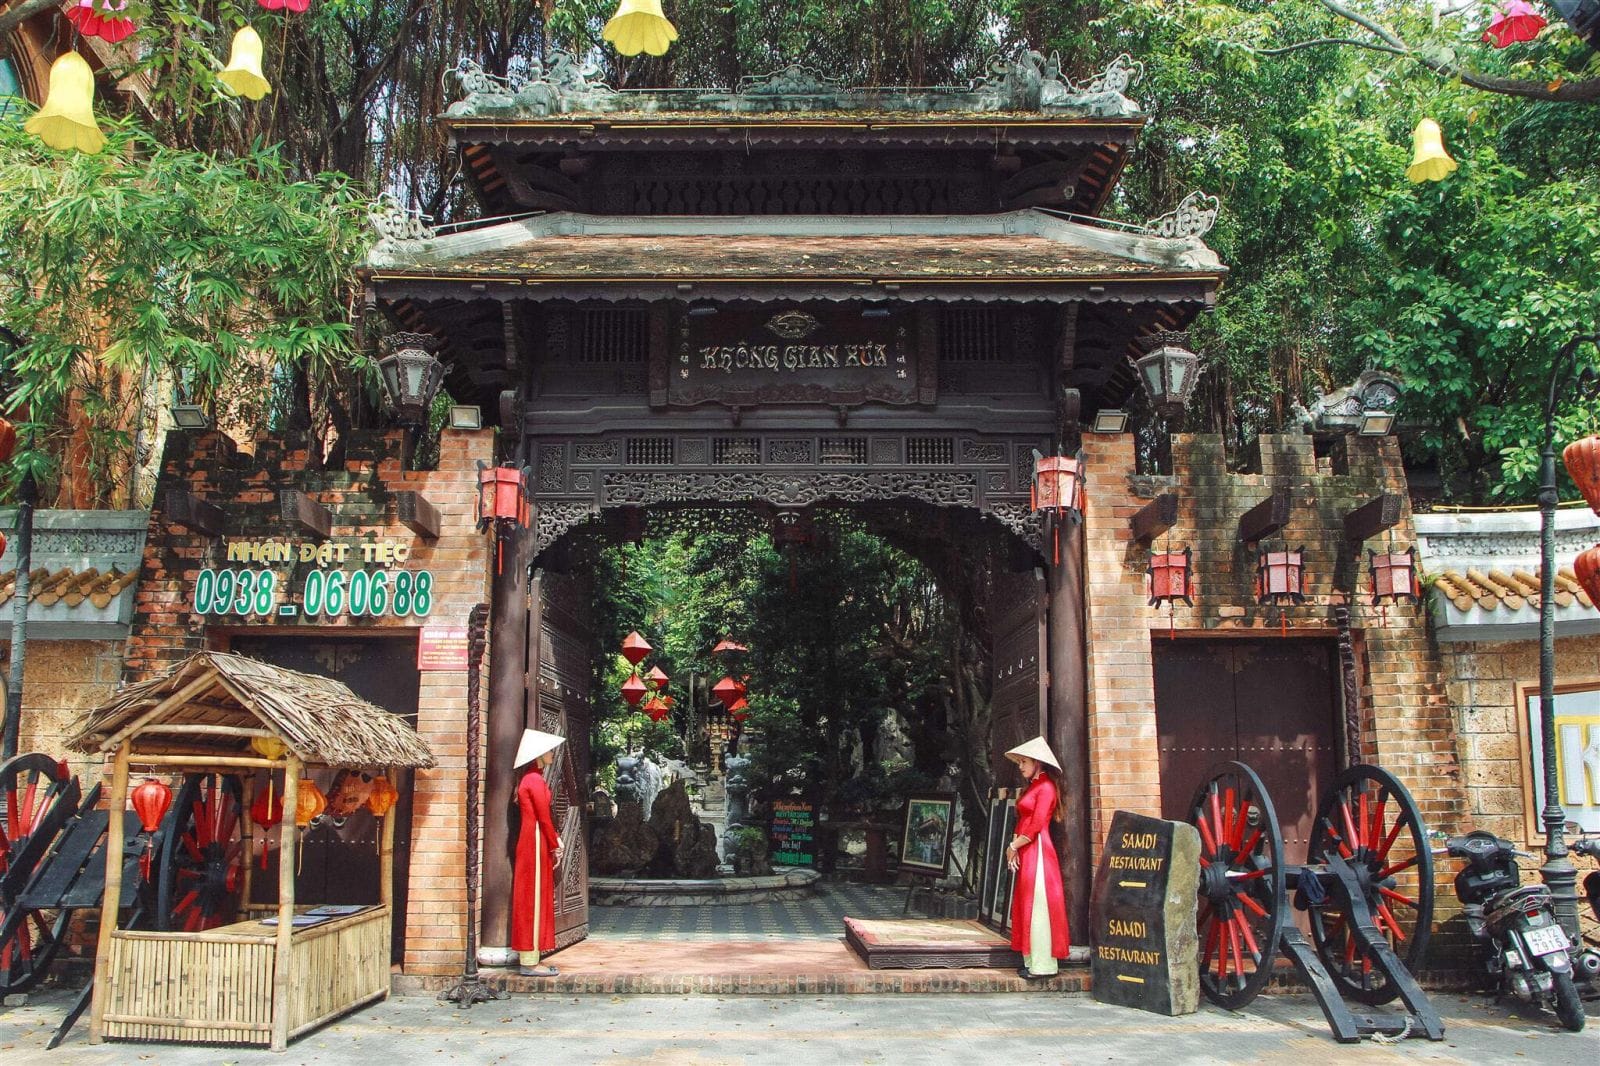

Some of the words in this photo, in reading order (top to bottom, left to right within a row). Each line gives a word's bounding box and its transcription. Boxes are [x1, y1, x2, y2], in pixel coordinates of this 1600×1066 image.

[783, 344, 840, 372] GIAN
[227, 539, 291, 566] NHẬN
[299, 540, 349, 567] ĐẶT
[361, 539, 408, 568] TIỆC
[194, 568, 276, 616] 0938
[1121, 833, 1157, 850] SAMDI
[1109, 856, 1164, 872] RESTAURANT
[1109, 919, 1147, 939] SAMDI
[1098, 946, 1161, 966] RESTAURANT
